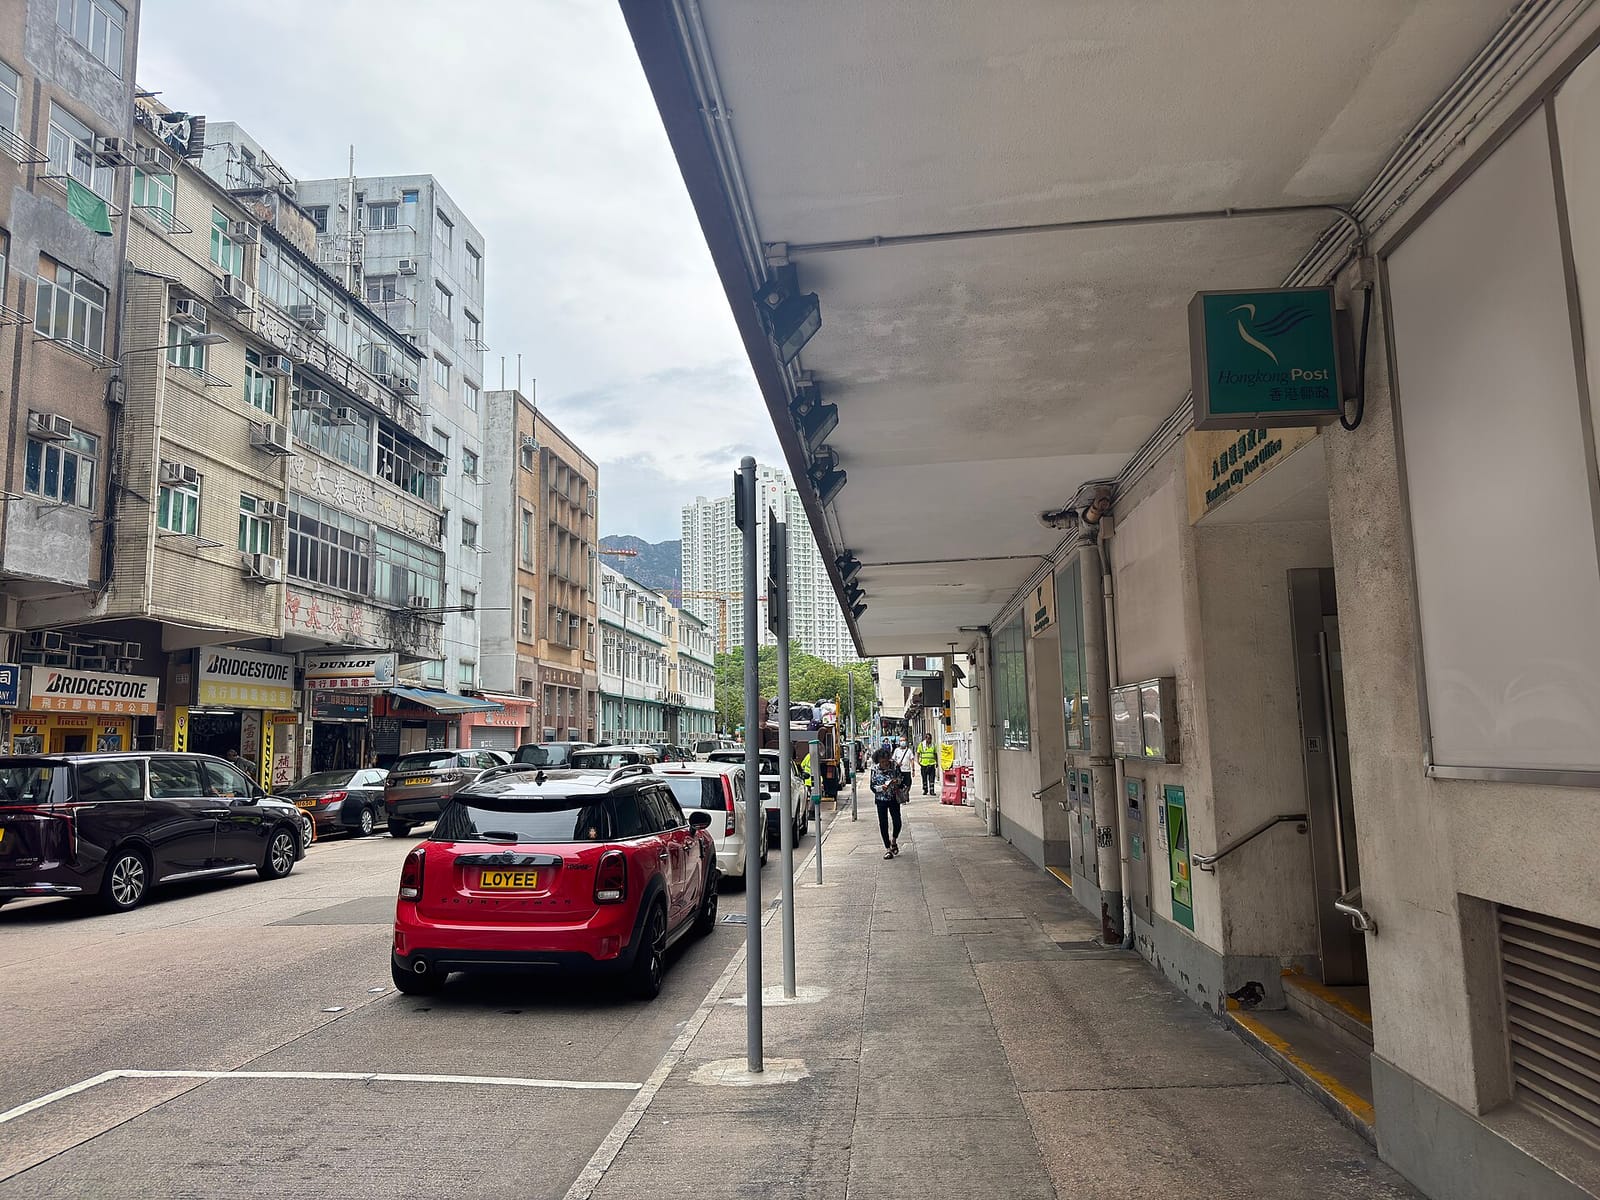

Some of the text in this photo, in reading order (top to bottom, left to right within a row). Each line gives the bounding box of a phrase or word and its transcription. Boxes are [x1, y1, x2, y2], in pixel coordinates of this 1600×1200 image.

[1218, 368, 1329, 386] Hongkong Post
[207, 655, 289, 681] BRIDGESTONE
[318, 660, 376, 669] DUNLOP
[46, 672, 148, 699] BRIDGESTONE
[13, 714, 48, 726] PIRELLI
[57, 715, 88, 726] PIRELLI
[97, 716, 126, 727] PIRELLI
